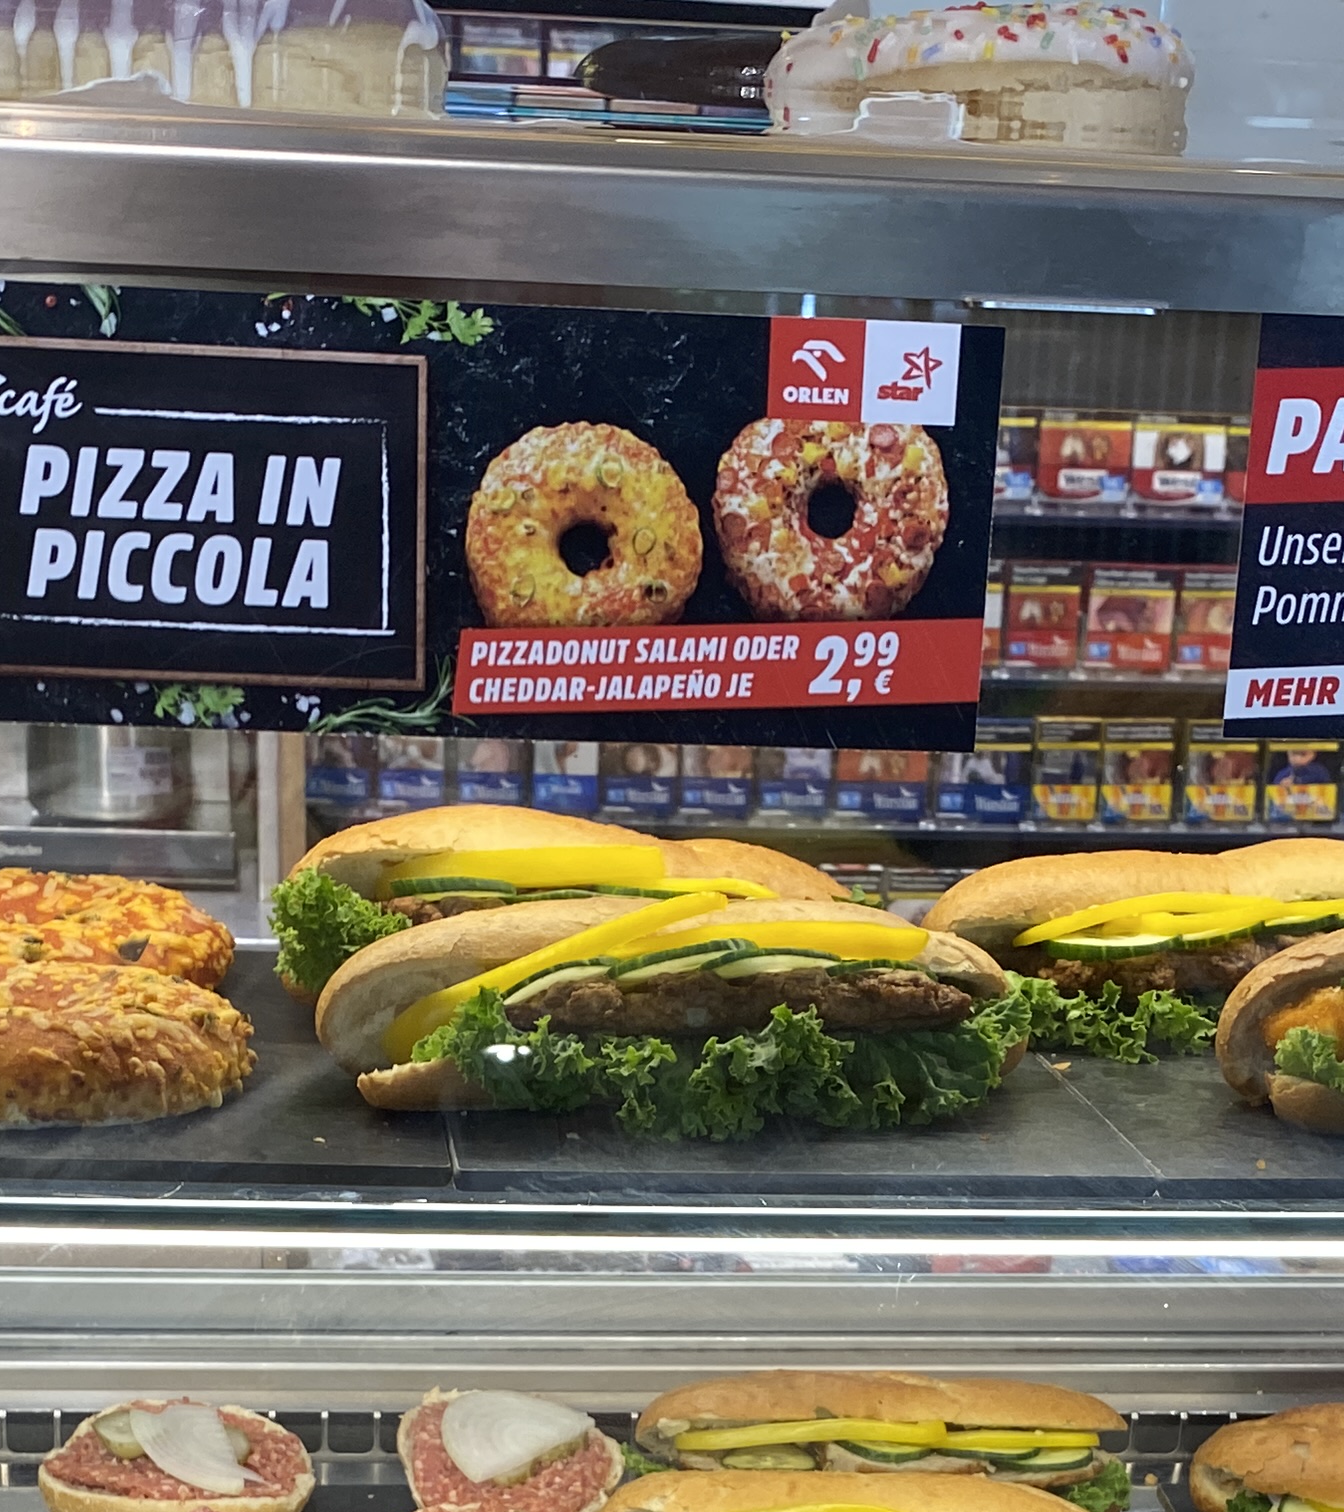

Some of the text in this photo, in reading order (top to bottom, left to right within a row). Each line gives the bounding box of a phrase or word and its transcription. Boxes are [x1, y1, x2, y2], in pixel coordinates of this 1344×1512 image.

[782, 385, 849, 405] ORLEN
[876, 380, 924, 402] star
[19, 443, 342, 527] PIZZA IN
[26, 527, 330, 609] PICCOLA
[470, 633, 800, 667] PIZZADONUT SALAMI ODER
[468, 669, 755, 704] CHEDDAR-JALAPEÑO JE
[1245, 674, 1341, 708] MEHR
